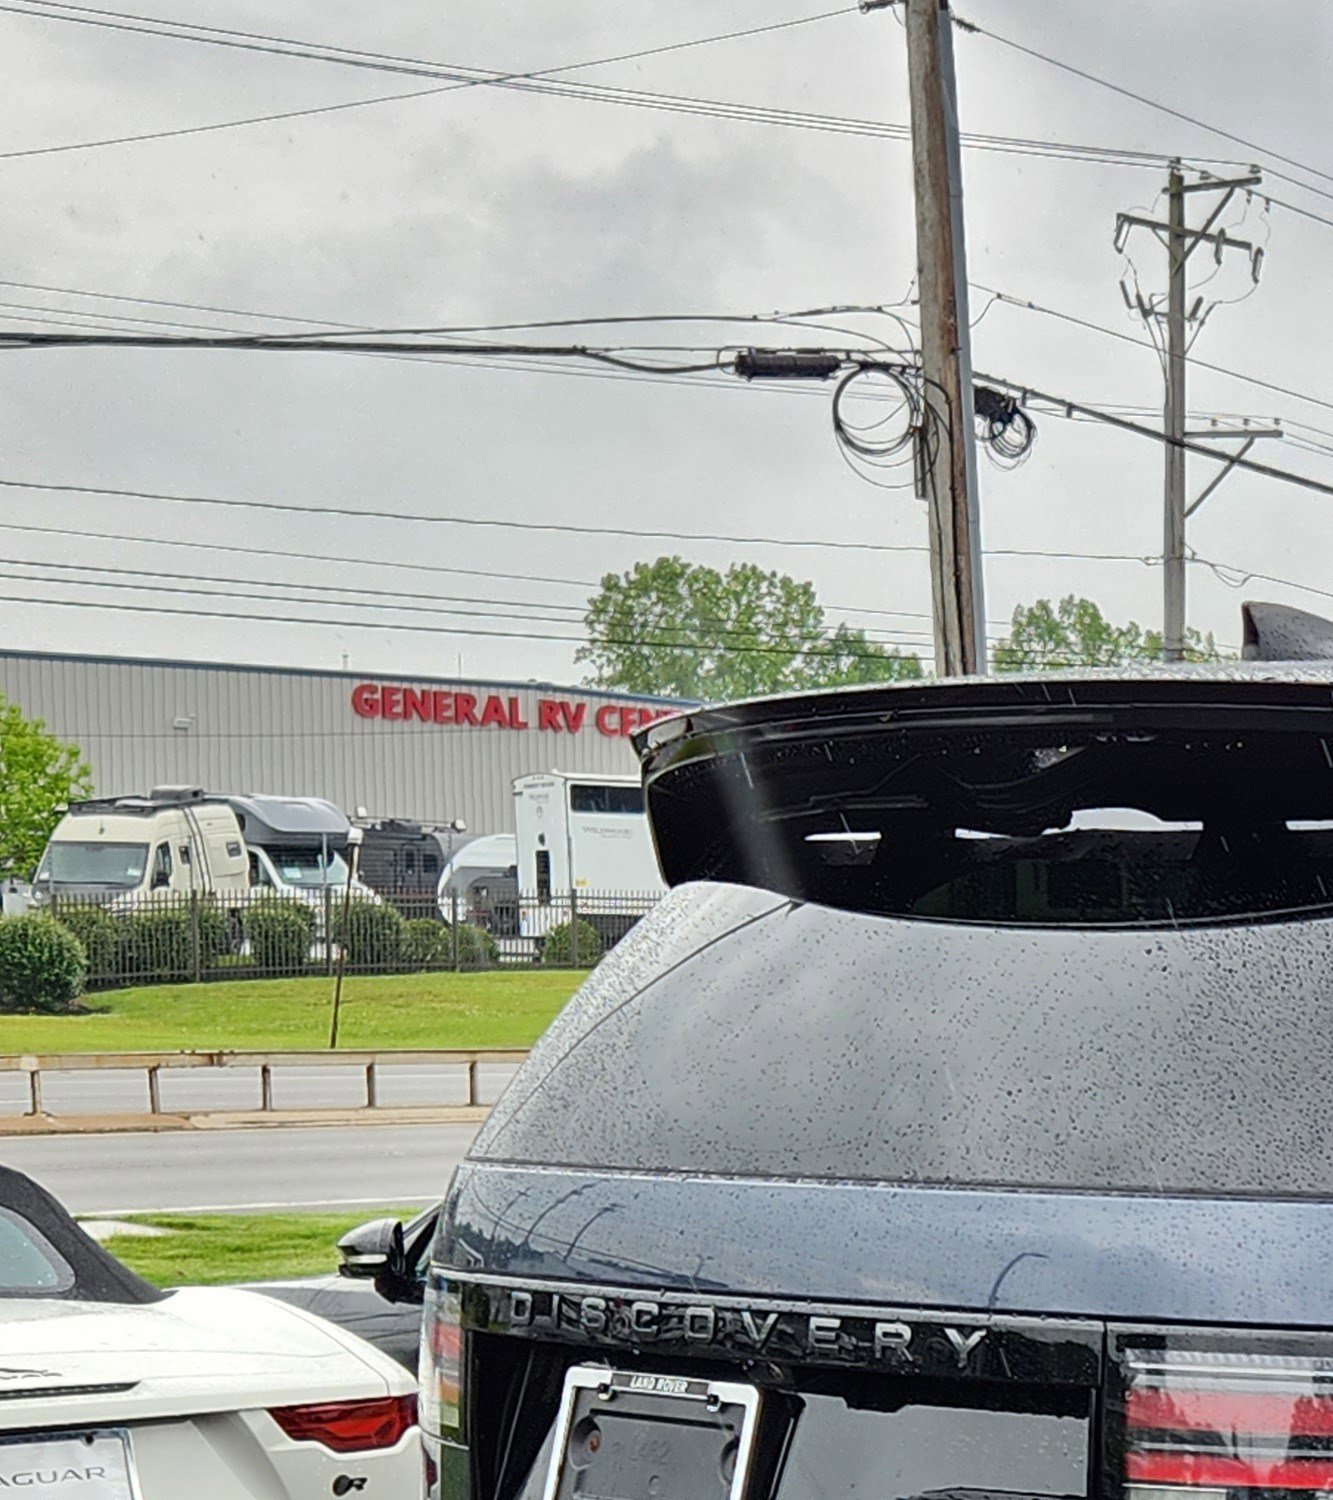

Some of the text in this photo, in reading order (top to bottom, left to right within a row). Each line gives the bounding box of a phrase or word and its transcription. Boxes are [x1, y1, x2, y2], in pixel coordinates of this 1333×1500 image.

[351, 684, 682, 737] GENERAL RV CEN
[508, 1291, 988, 1369] DISCOVERY
[630, 1375, 688, 1393] LAND ROVER
